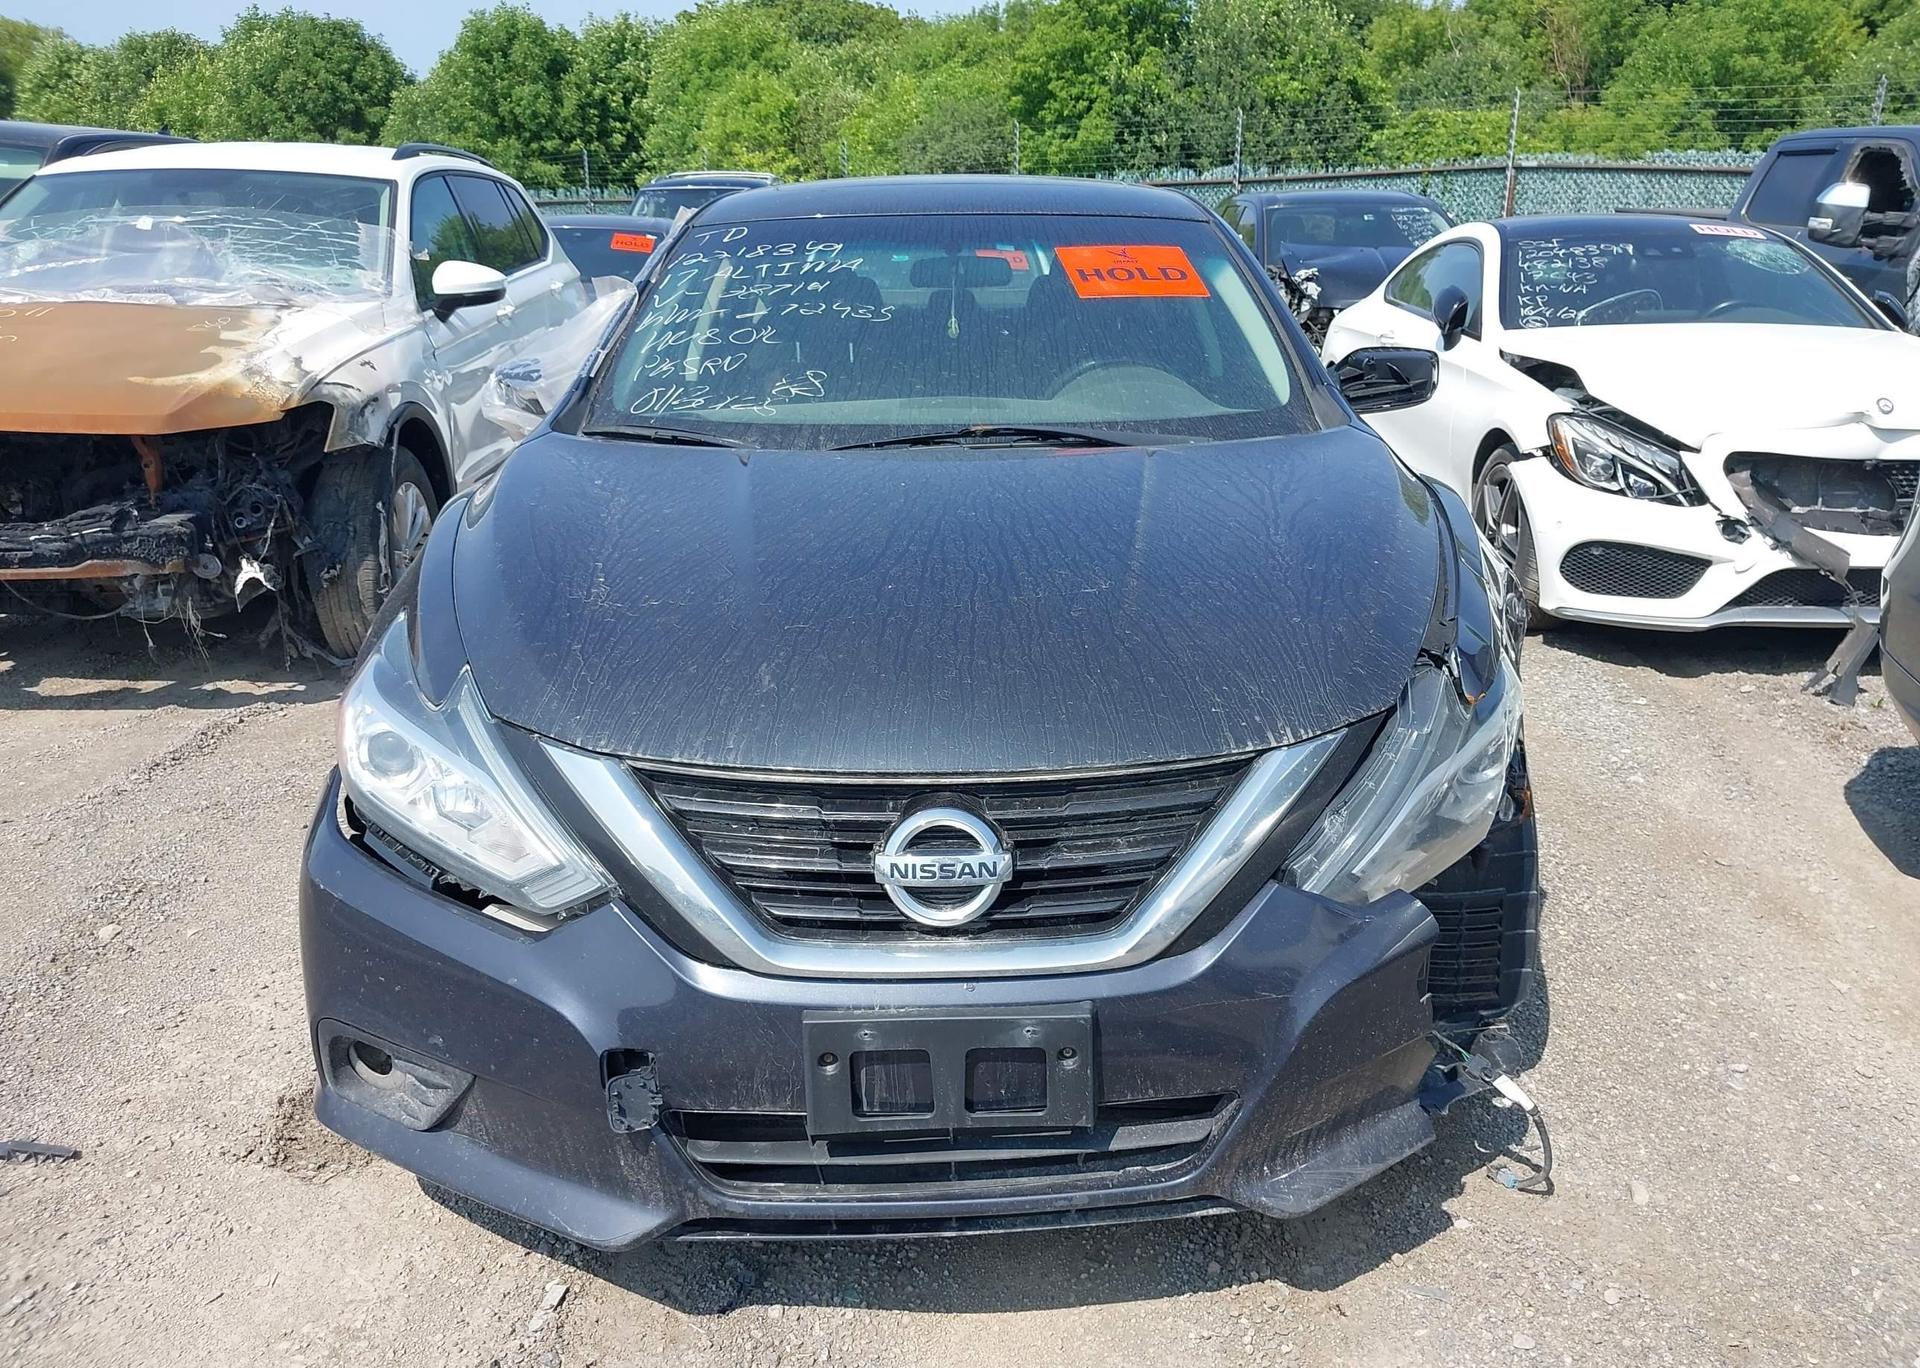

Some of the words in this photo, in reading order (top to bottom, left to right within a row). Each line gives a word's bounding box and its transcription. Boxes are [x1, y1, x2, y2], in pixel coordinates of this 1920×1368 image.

[615, 240, 650, 248] HOLD
[704, 257, 864, 281] ALTIMA
[1075, 267, 1188, 282] HOLD
[890, 861, 998, 880] NISSAN
